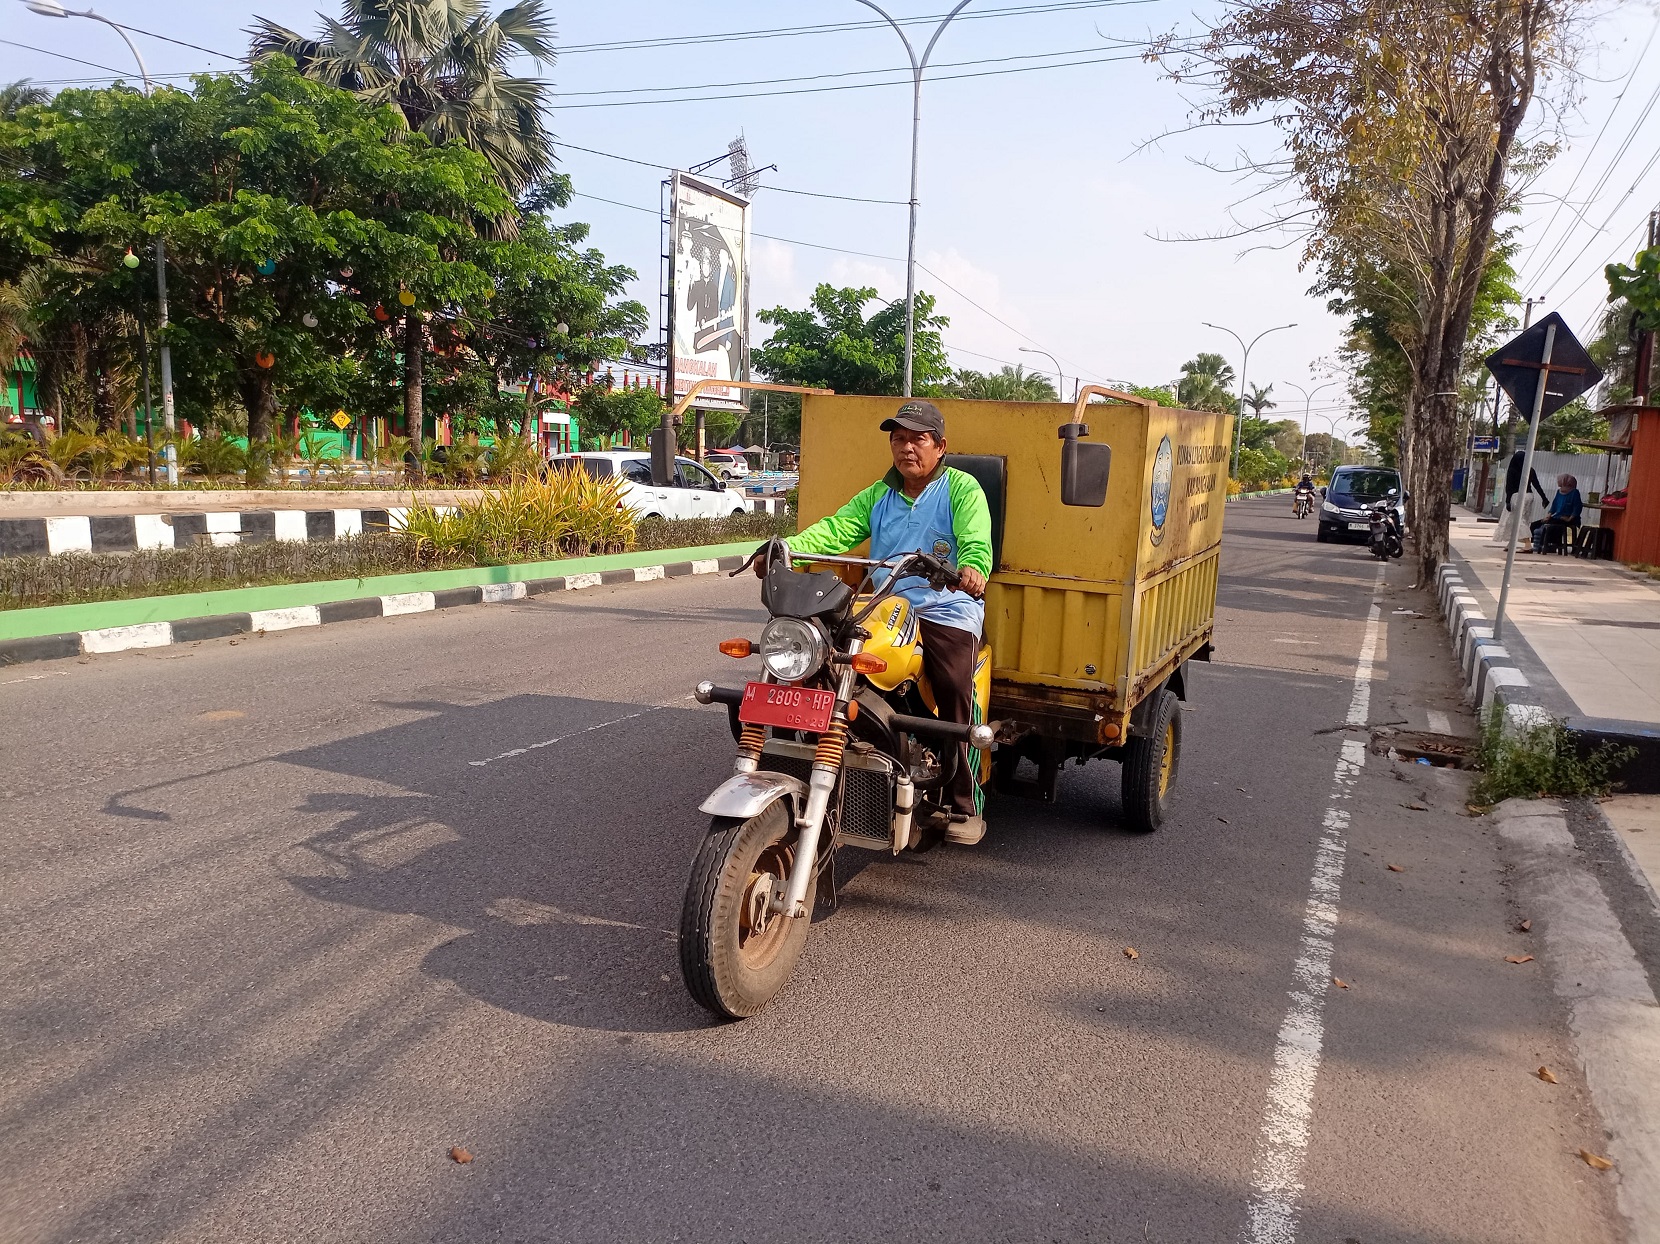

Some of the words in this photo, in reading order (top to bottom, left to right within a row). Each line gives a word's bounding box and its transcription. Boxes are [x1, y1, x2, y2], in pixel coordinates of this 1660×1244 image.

[675, 356, 717, 378] BANGKALAN
[745, 685, 756, 701] M
[767, 688, 801, 706] 2809
[812, 693, 831, 710] HP
